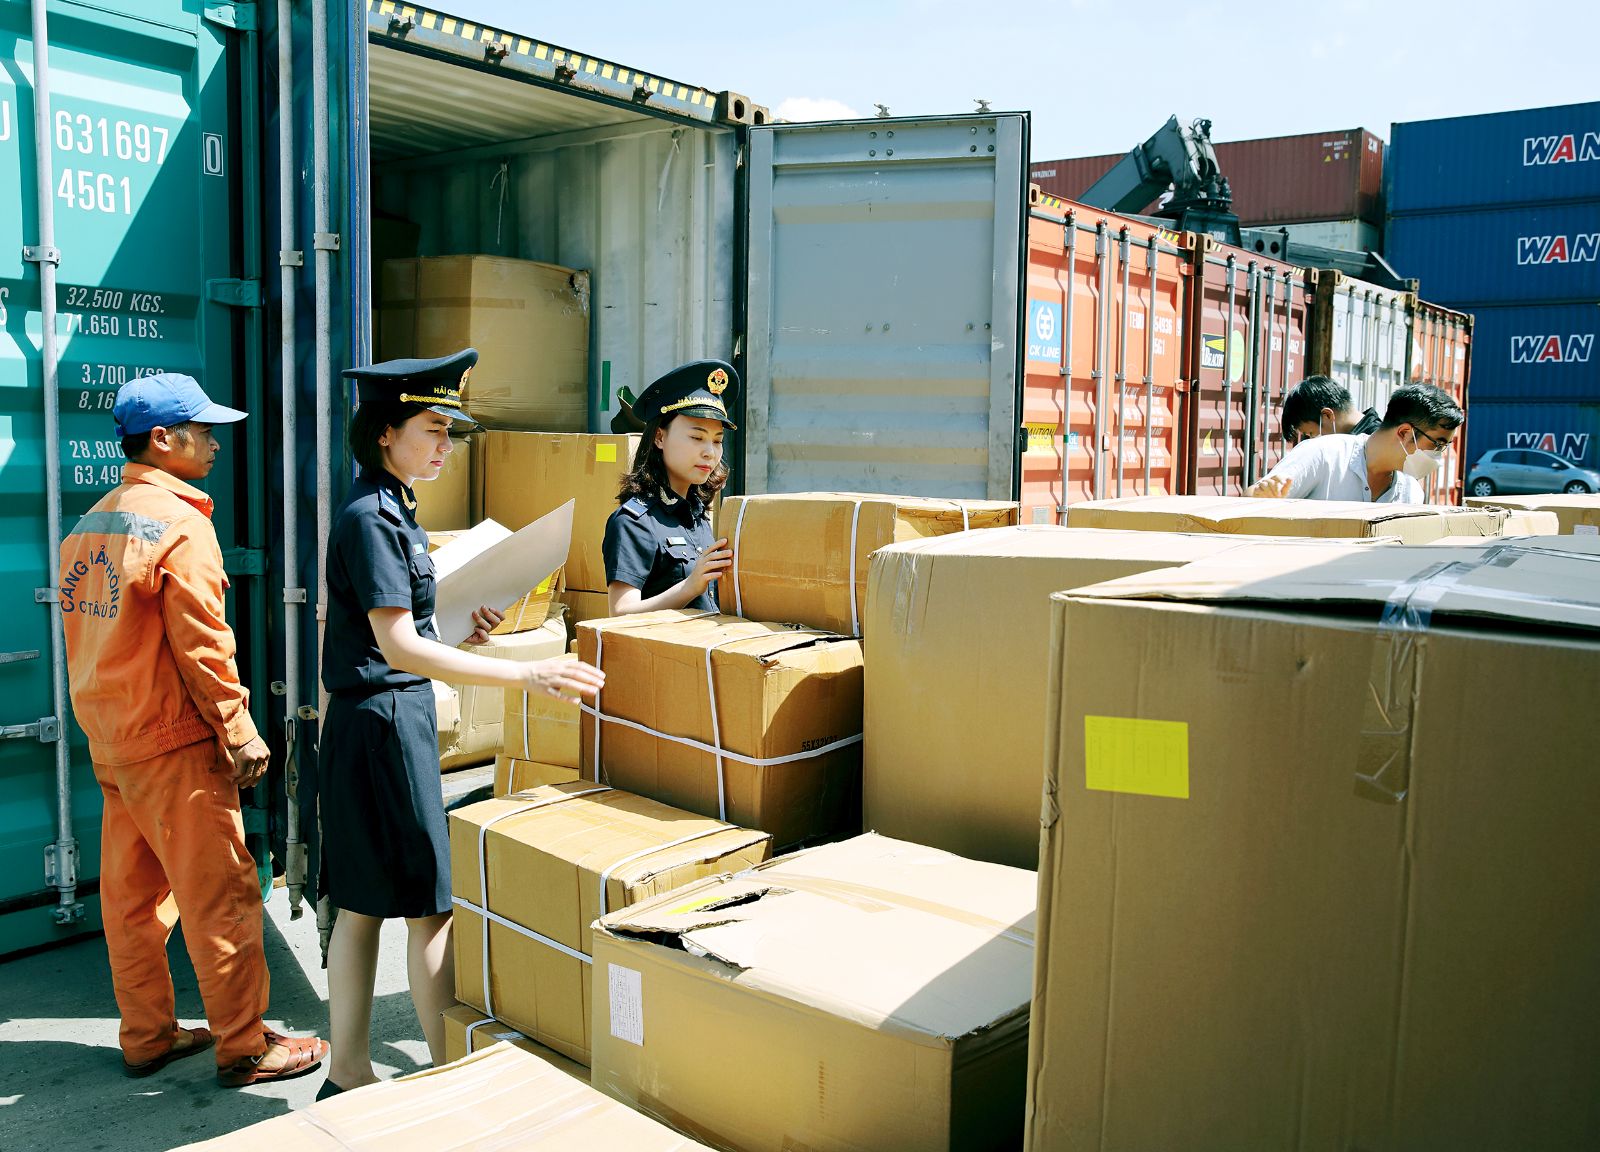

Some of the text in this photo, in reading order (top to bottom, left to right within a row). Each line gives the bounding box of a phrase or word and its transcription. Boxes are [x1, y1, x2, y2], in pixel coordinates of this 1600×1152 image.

[55, 110, 169, 164] 631697
[205, 135, 221, 174] 0
[1523, 132, 1600, 166] WAN
[57, 168, 131, 215] 45G1
[1517, 233, 1600, 265] WAN
[66, 287, 165, 314] 32,500 KGS.
[64, 312, 164, 339] 71,650 LBS.
[1029, 344, 1060, 359] CK LINE
[1511, 334, 1595, 363] WAN
[81, 363, 126, 385] 3,700
[78, 391, 115, 410] 8,16
[1507, 433, 1589, 460] WAN
